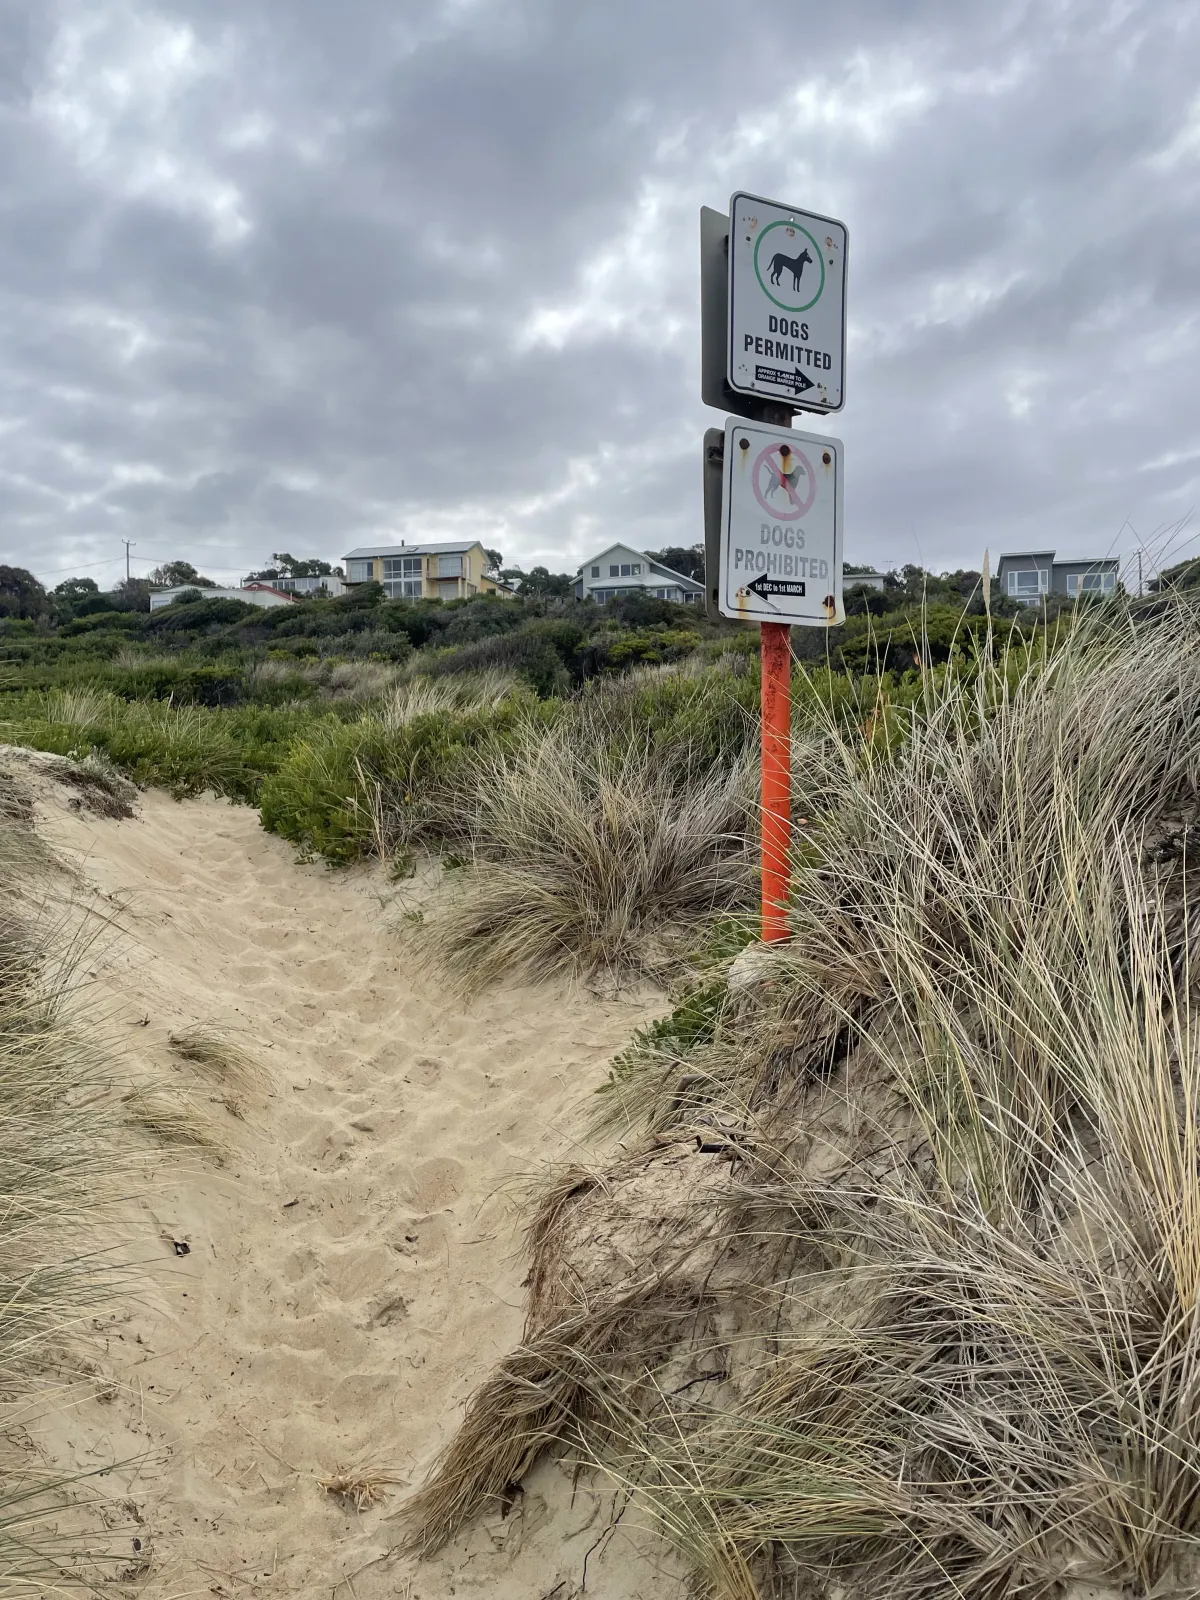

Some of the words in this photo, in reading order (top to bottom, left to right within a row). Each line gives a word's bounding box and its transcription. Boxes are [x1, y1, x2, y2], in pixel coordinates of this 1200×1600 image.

[769, 315, 808, 340] DOGS
[744, 334, 831, 370] PERMITTED
[757, 374, 776, 382] ORANGE
[777, 377, 794, 386] MARKER
[760, 523, 805, 549] DOGS
[734, 548, 828, 579] PROHIBITED
[763, 583, 772, 592] DEC
[773, 584, 778, 592] to
[786, 584, 802, 593] MARCH
